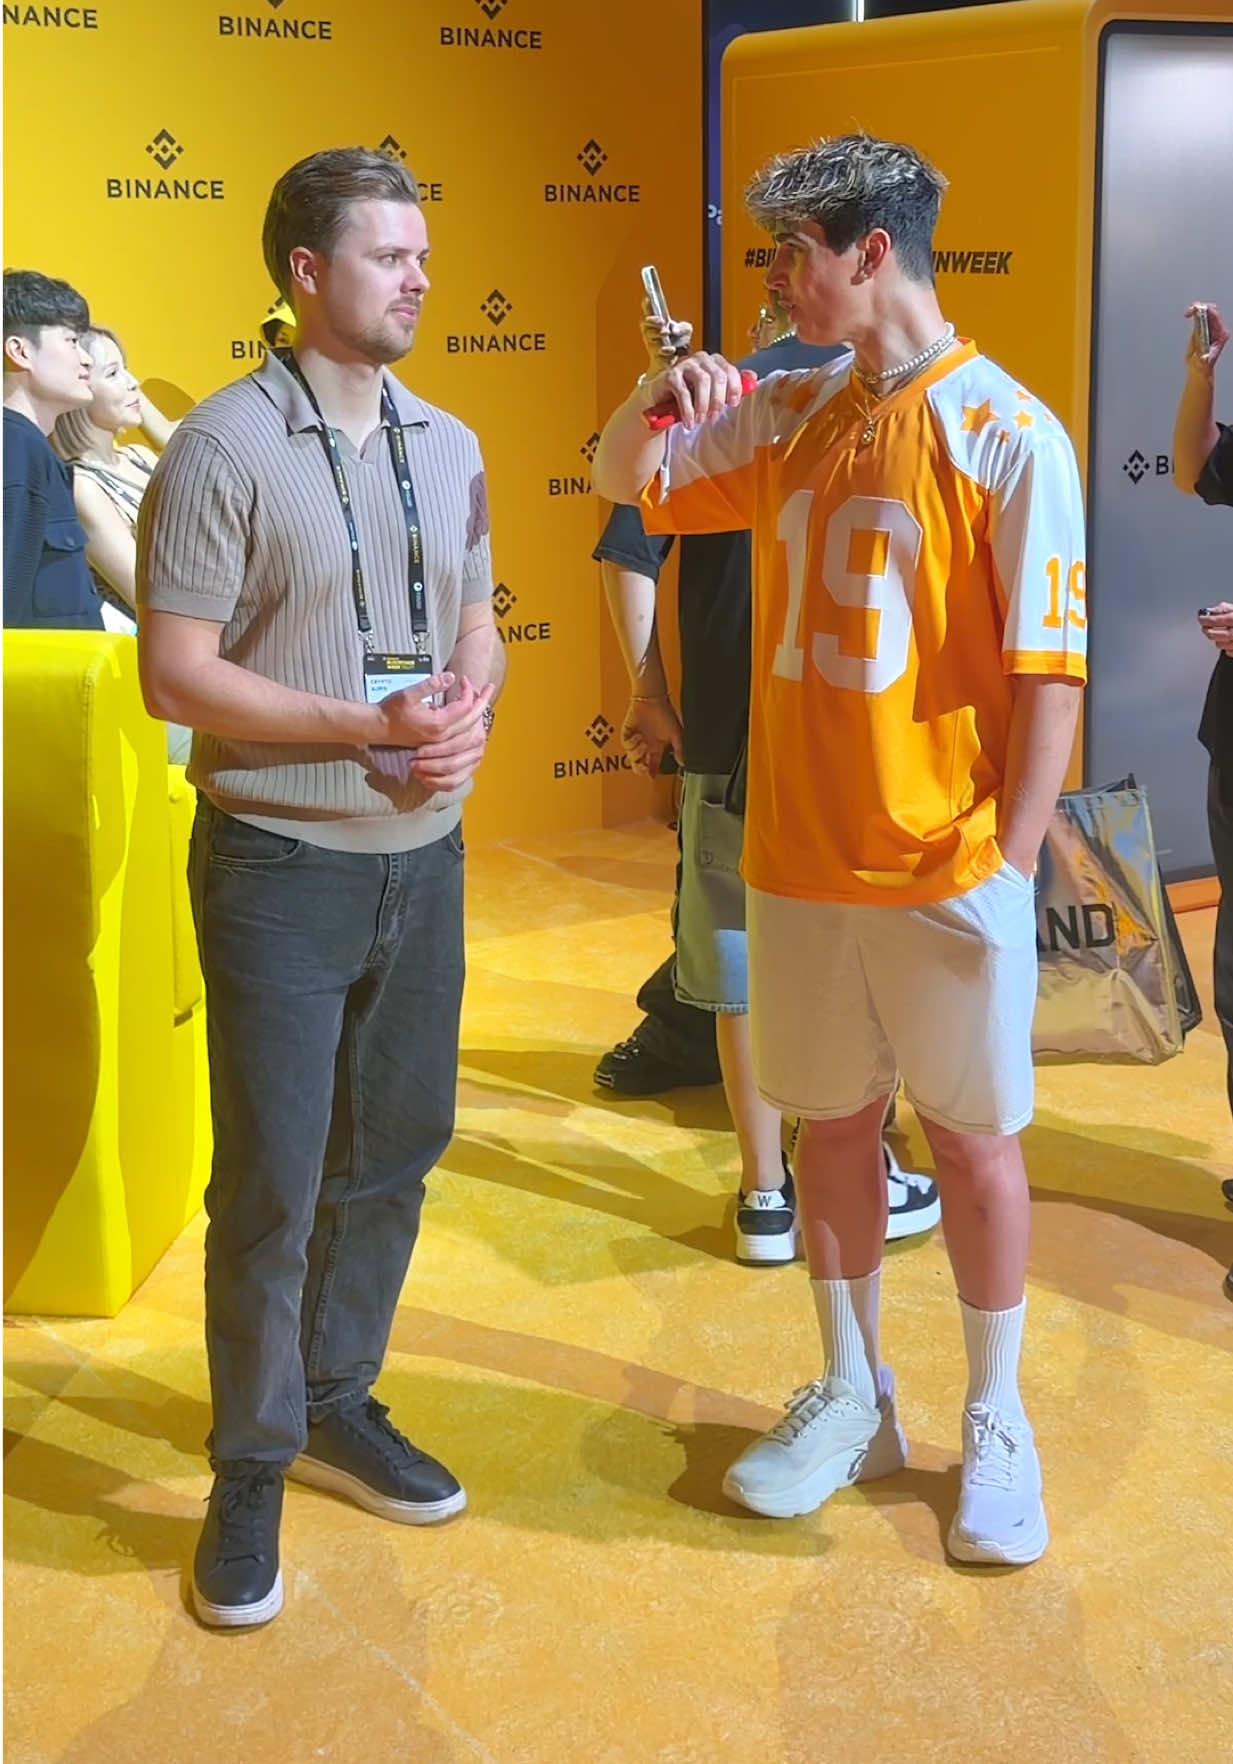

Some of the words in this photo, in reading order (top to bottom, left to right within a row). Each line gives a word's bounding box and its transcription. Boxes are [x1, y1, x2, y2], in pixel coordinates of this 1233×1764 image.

[219, 15, 332, 40] BINANCE
[440, 27, 543, 49] BINANCE
[106, 178, 224, 199] BINANCE
[544, 184, 641, 202] BINANCE
[447, 333, 546, 353] BINANCE
[772, 489, 923, 693] 19
[1043, 556, 1086, 630] 19
[757, 1194, 772, 1208] W
